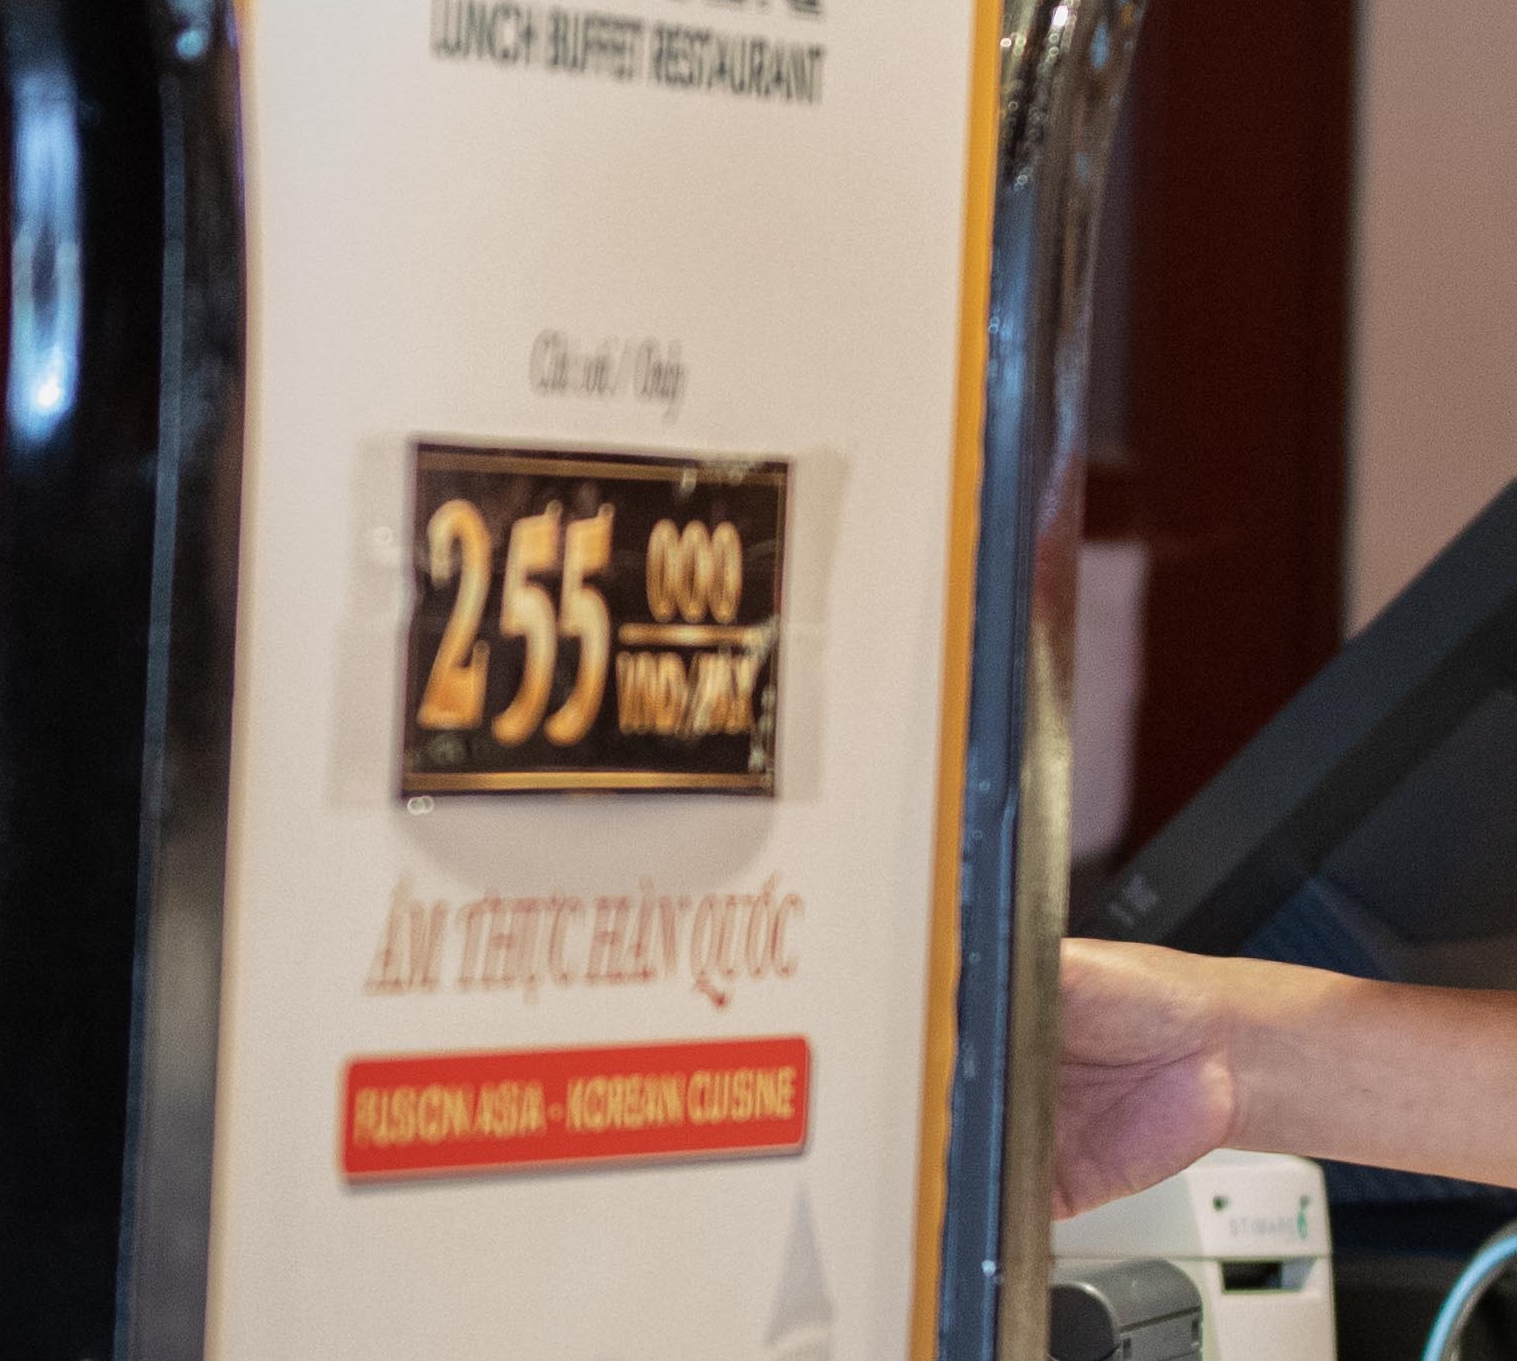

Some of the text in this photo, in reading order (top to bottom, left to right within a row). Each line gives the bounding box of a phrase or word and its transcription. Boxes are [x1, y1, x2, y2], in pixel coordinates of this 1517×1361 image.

[547, 4, 643, 81] BUFFET
[650, 19, 825, 104] RESTAURANT
[417, 498, 743, 747] 255 000
[354, 1086, 468, 1146] FUSION
[475, 1080, 547, 1136] ASIA
[565, 1072, 684, 1133] KOREAN
[687, 1066, 798, 1123] CUISINE
